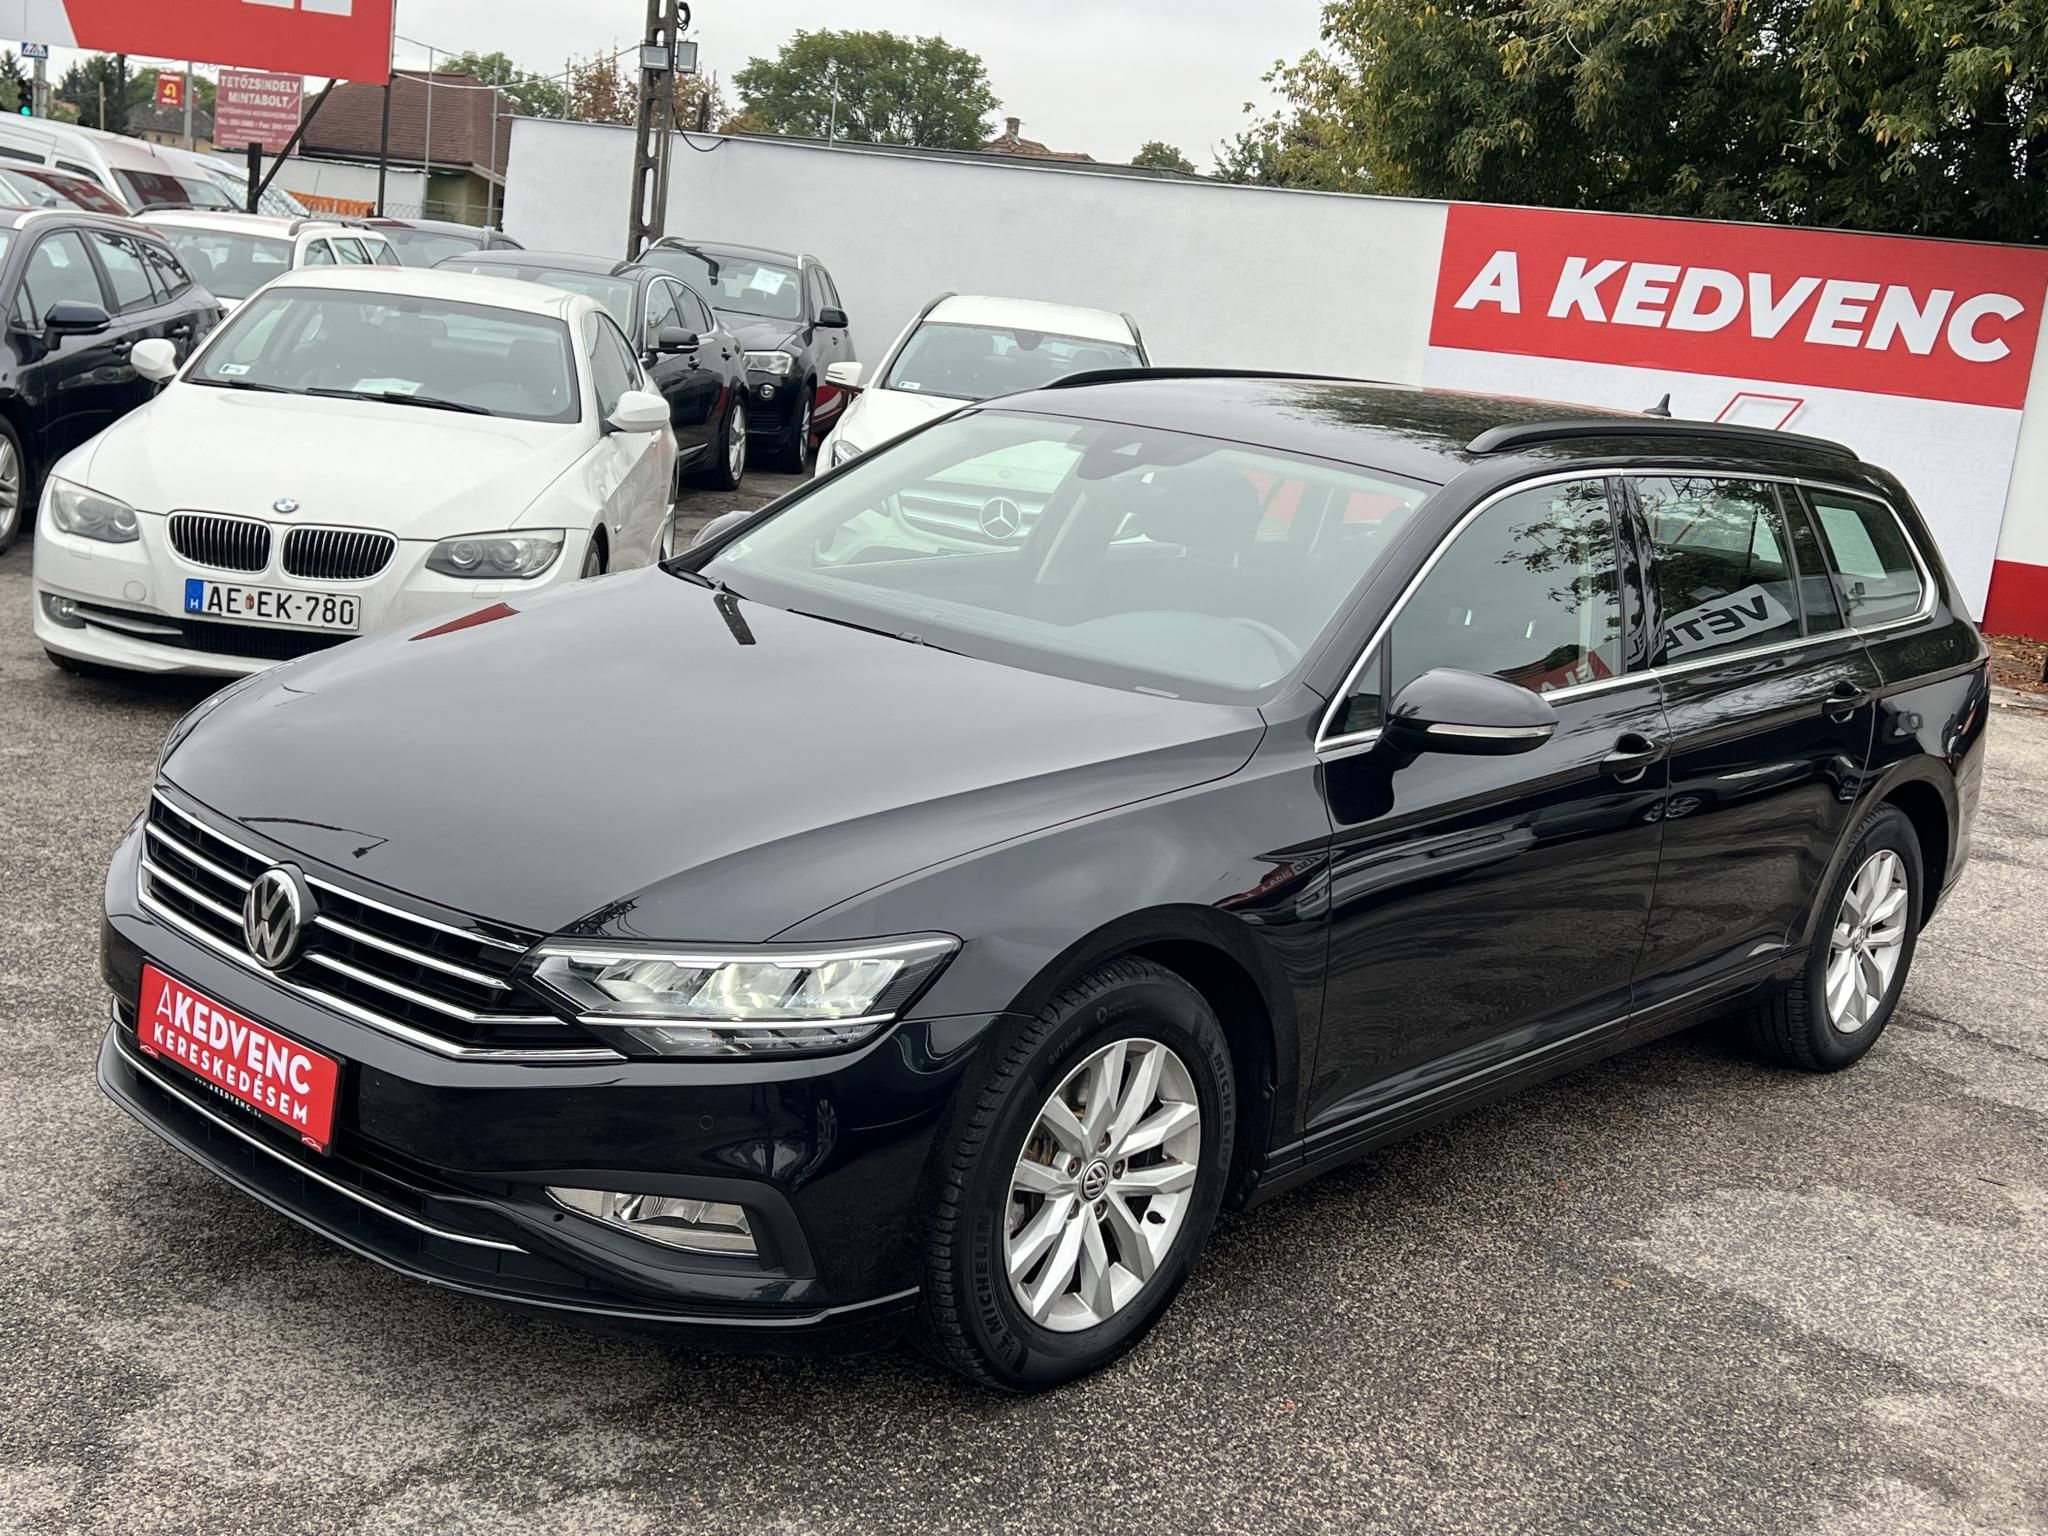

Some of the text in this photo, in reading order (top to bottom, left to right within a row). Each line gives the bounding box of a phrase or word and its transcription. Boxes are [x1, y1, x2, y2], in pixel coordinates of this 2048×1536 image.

[220, 75, 299, 94] TETŐZSINDELY
[228, 91, 289, 108] MINTABOLT
[1454, 250, 2025, 363] A KEDVENC
[207, 586, 242, 614] AE
[257, 591, 354, 625] EK-780
[153, 1022, 308, 1125] KERESKEDÉSEM
[975, 1212, 1002, 1335] MICHELIN
